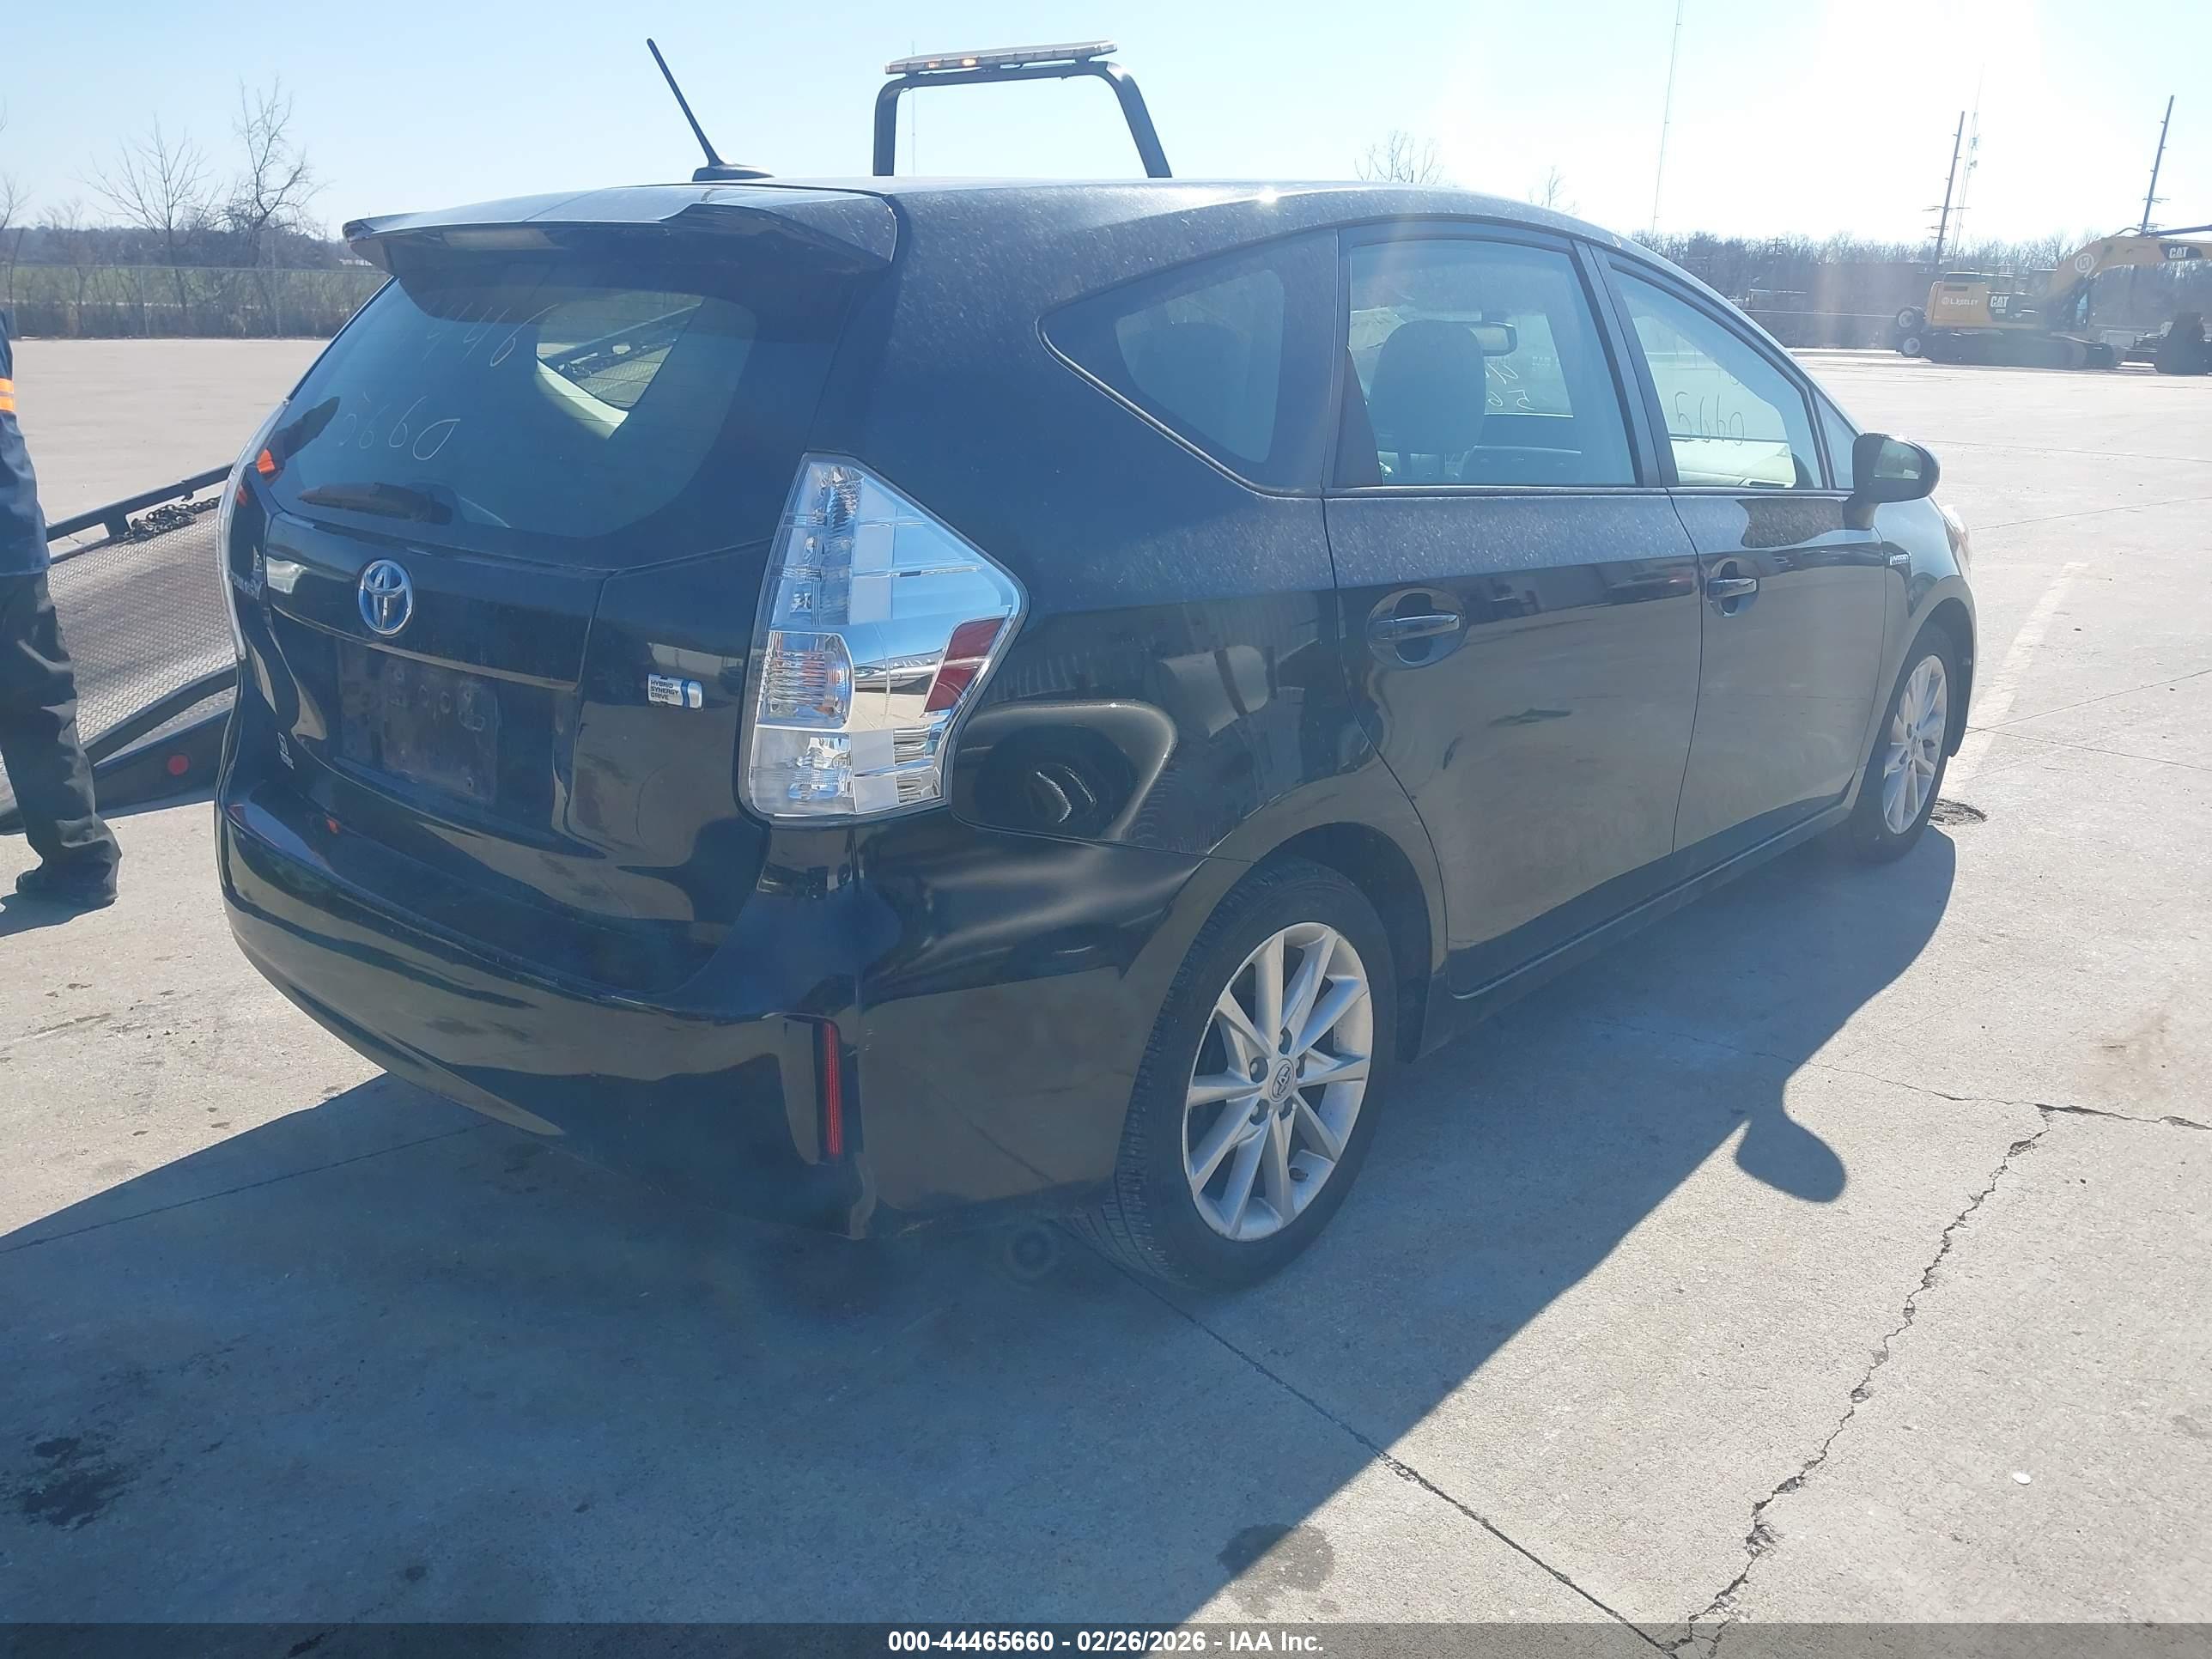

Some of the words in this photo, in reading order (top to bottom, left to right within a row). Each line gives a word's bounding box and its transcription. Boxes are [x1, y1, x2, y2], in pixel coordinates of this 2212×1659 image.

[2169, 246, 2189, 258] CAT
[1990, 295, 2009, 307] CAT
[650, 679, 674, 689] HYBRID
[650, 686, 679, 696] SYNERGY
[650, 692, 670, 701] DRIVE
